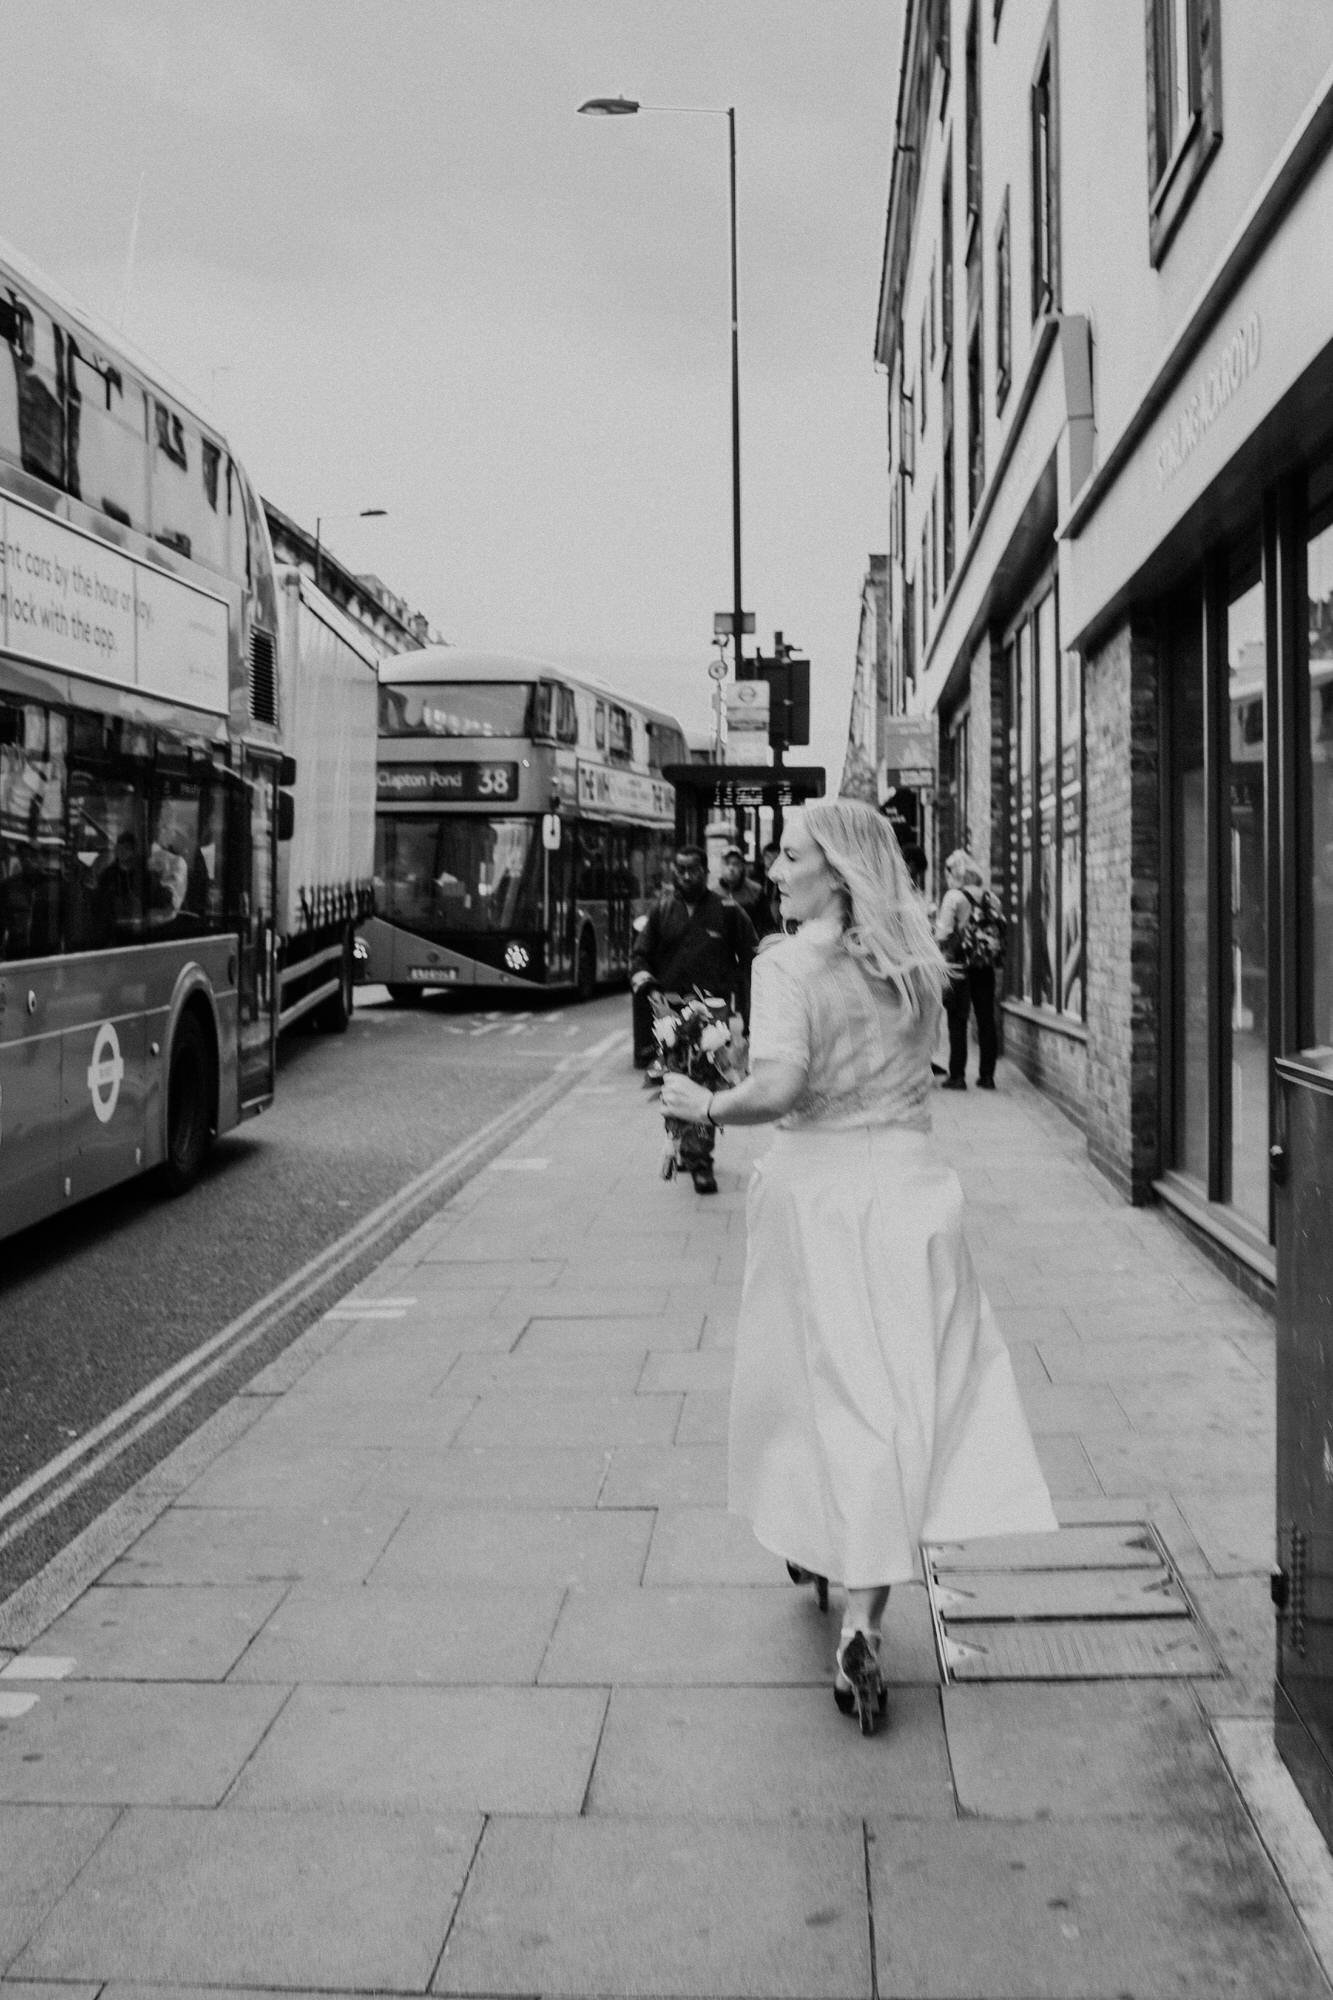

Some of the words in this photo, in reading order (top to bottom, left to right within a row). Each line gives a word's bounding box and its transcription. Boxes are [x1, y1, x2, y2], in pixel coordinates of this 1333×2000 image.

[25, 552, 51, 582] cars
[54, 554, 69, 600] by
[72, 565, 92, 597] the
[94, 571, 119, 608] hour
[40, 599, 68, 636] with
[71, 611, 91, 643] the
[377, 770, 427, 791] Clapton
[430, 770, 462, 788] Pond
[478, 768, 509, 795] 38
